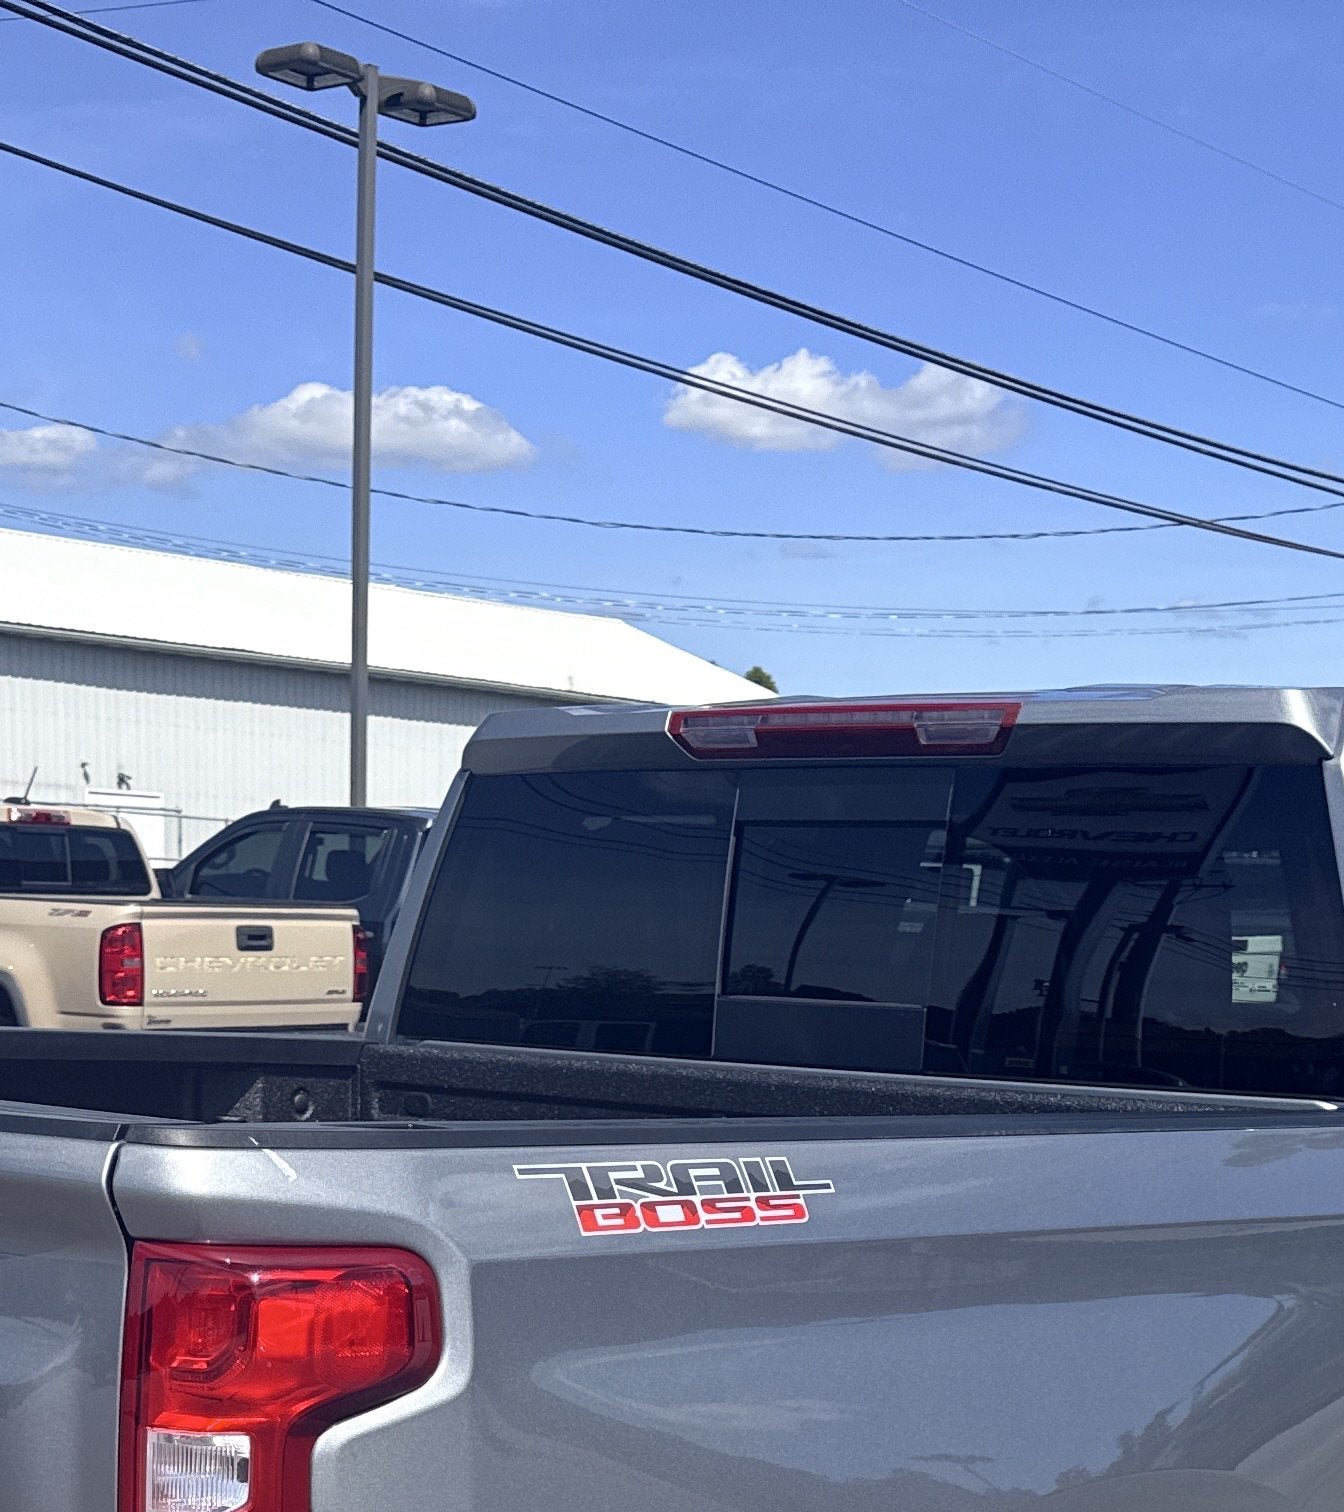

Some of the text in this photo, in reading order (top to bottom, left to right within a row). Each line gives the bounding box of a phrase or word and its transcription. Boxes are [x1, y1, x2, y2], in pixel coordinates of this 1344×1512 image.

[155, 955, 347, 973] CHEVROLET
[511, 1156, 836, 1201] TRAIL
[575, 1193, 810, 1237] BOSS
